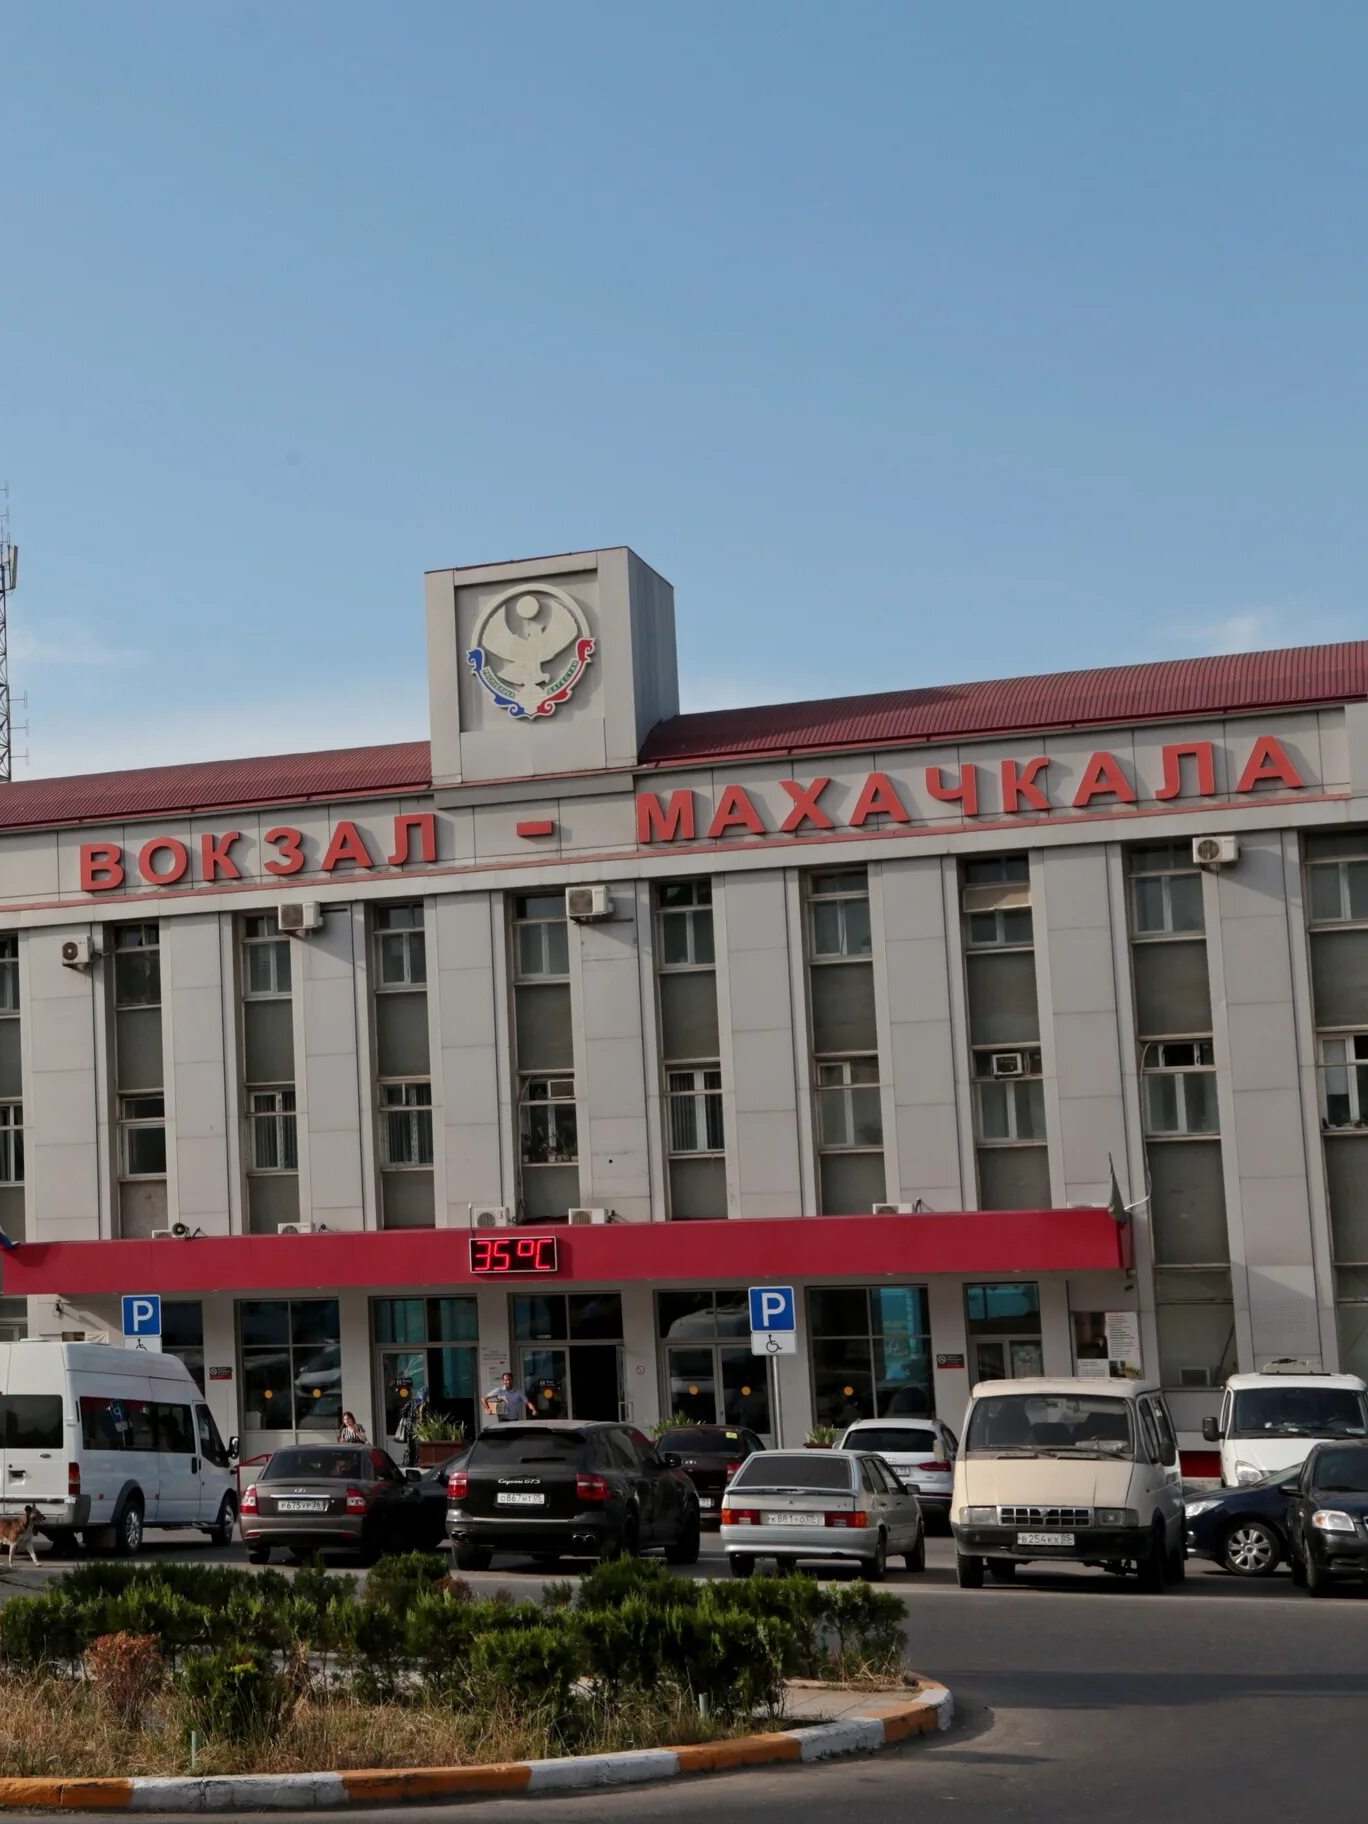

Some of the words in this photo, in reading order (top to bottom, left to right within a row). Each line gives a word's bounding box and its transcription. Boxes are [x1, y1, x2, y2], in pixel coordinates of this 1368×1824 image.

[80, 812, 436, 891] ВОКЗАЛ
[636, 735, 1303, 844] МАХАЧКАЛА
[133, 1300, 154, 1332] P
[761, 1292, 786, 1327] P
